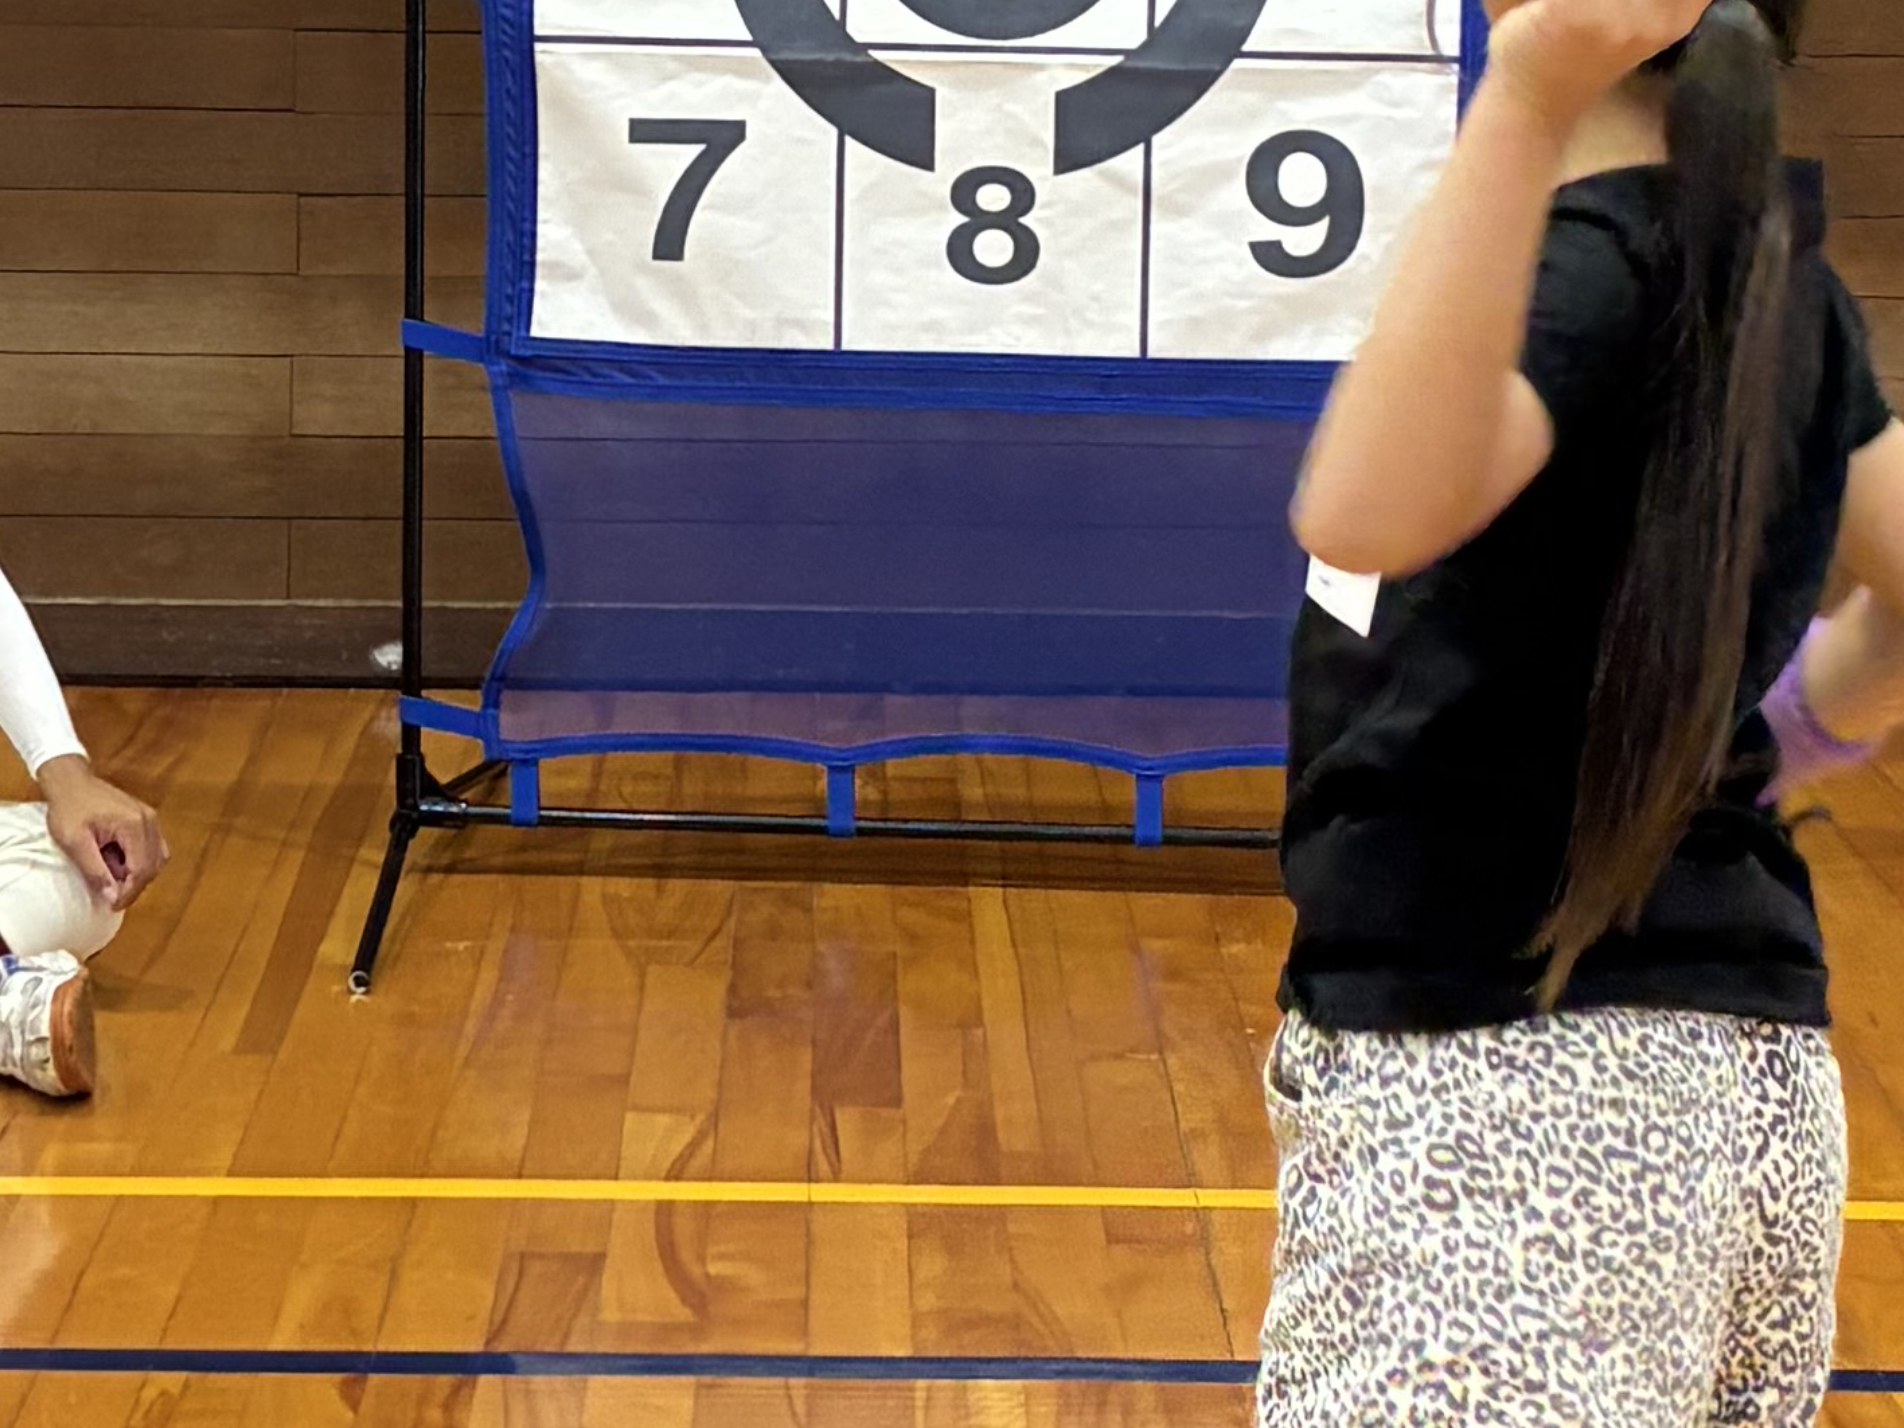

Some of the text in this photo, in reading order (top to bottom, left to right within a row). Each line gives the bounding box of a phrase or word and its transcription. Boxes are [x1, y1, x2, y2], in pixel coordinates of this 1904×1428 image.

[629, 119, 745, 261] 7
[947, 167, 1039, 284] 8
[1247, 131, 1364, 278] 9
